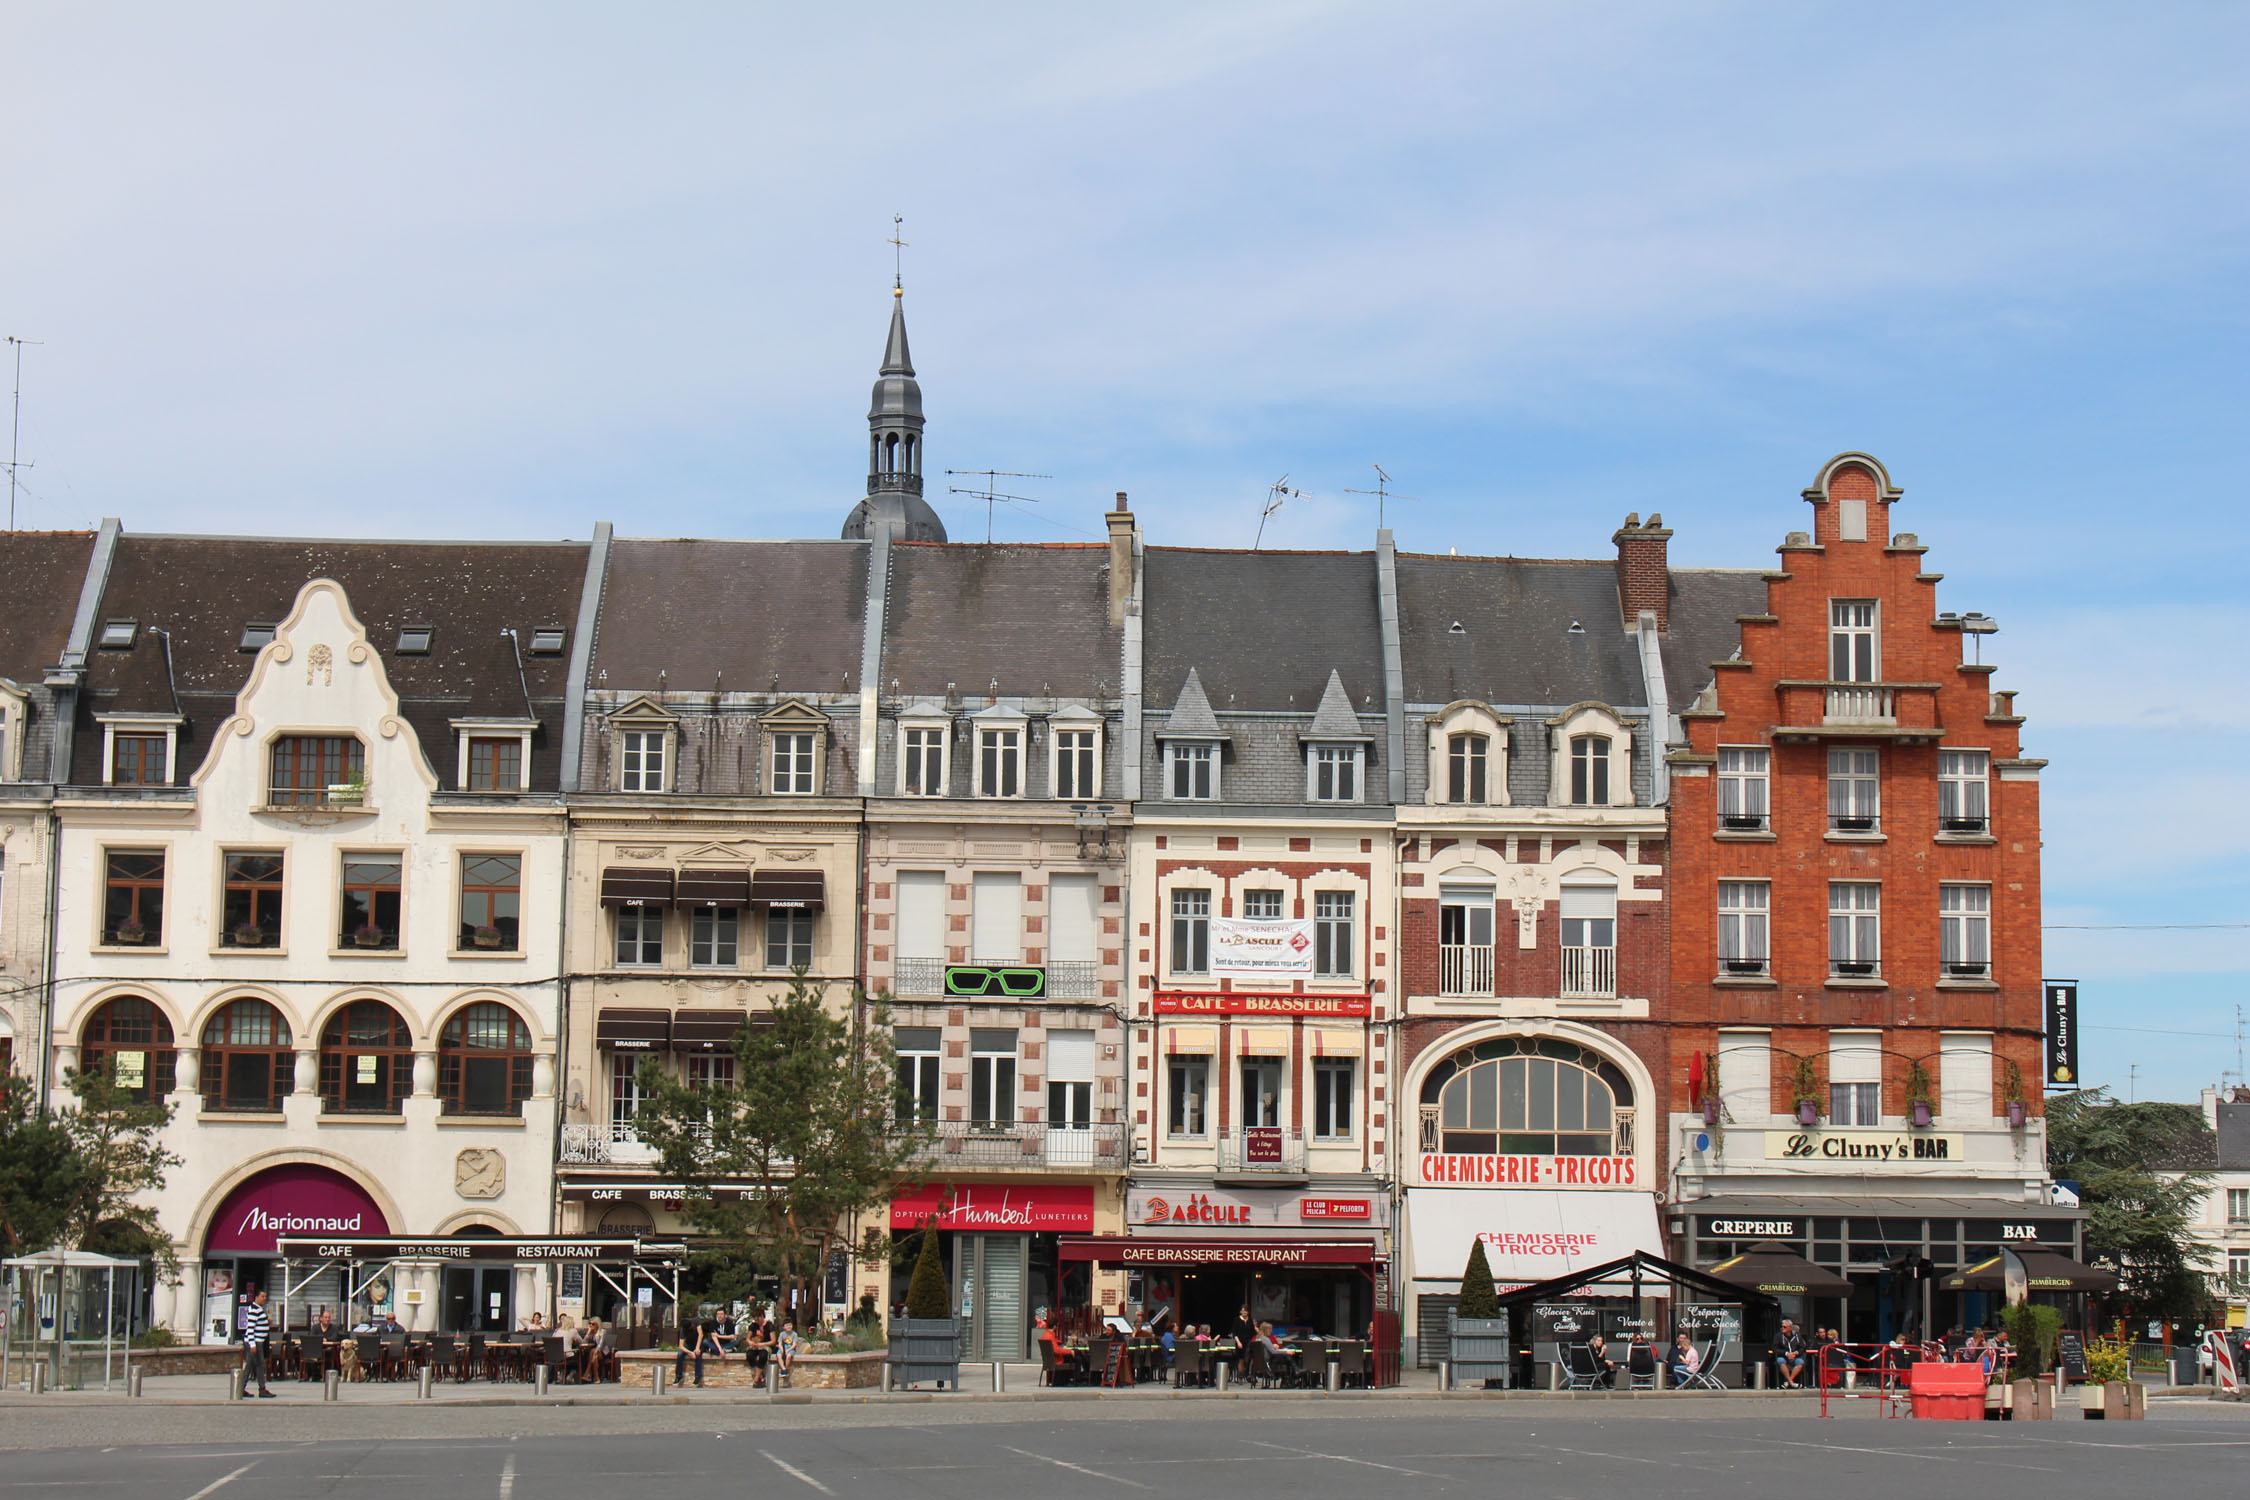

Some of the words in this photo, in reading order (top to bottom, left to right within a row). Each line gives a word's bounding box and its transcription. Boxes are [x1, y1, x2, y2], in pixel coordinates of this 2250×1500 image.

[1228, 934, 1284, 946] BASCULE
[1215, 958, 1227, 966] Sont
[1227, 958, 1233, 966] de
[1181, 996, 1226, 1010] CAFE
[1245, 997, 1344, 1012] BRASSERIE
[2056, 989, 2067, 1006] BAR
[2056, 1008, 2068, 1047] Cluny's
[2056, 1048, 2067, 1065] Le
[1783, 1134, 1818, 1157] Le
[1823, 1136, 1908, 1161] Cluny's
[1914, 1138, 1948, 1158] BAR
[1422, 1155, 1539, 1183] CHEMISERIE
[1555, 1157, 1635, 1184] TRICOTS
[592, 1190, 622, 1200] CAFE
[1191, 1193, 1208, 1204] LA
[949, 1189, 1033, 1224] Humbert
[1035, 1213, 1089, 1221] LUNETIERS
[1144, 1197, 1251, 1222] BASCULE
[1340, 1205, 1365, 1213] PELFORTH
[238, 1207, 361, 1236] Marionnaud
[1711, 1220, 1793, 1235] CREPERIE
[1475, 1232, 1598, 1245] CHEMISERIE
[2003, 1225, 2038, 1239] BAR
[318, 1245, 353, 1257] CAFE
[399, 1246, 471, 1257] BRASSERIE
[517, 1246, 602, 1258] RESTAURANT
[1123, 1248, 1154, 1260] CAFE
[1157, 1249, 1223, 1260] BRASSERIE
[1227, 1249, 1307, 1261] RESTAURANT
[1496, 1244, 1581, 1255] TRICOTS
[1759, 1284, 1805, 1292] GRIMBERGEN
[1616, 1315, 1647, 1327] Vente
